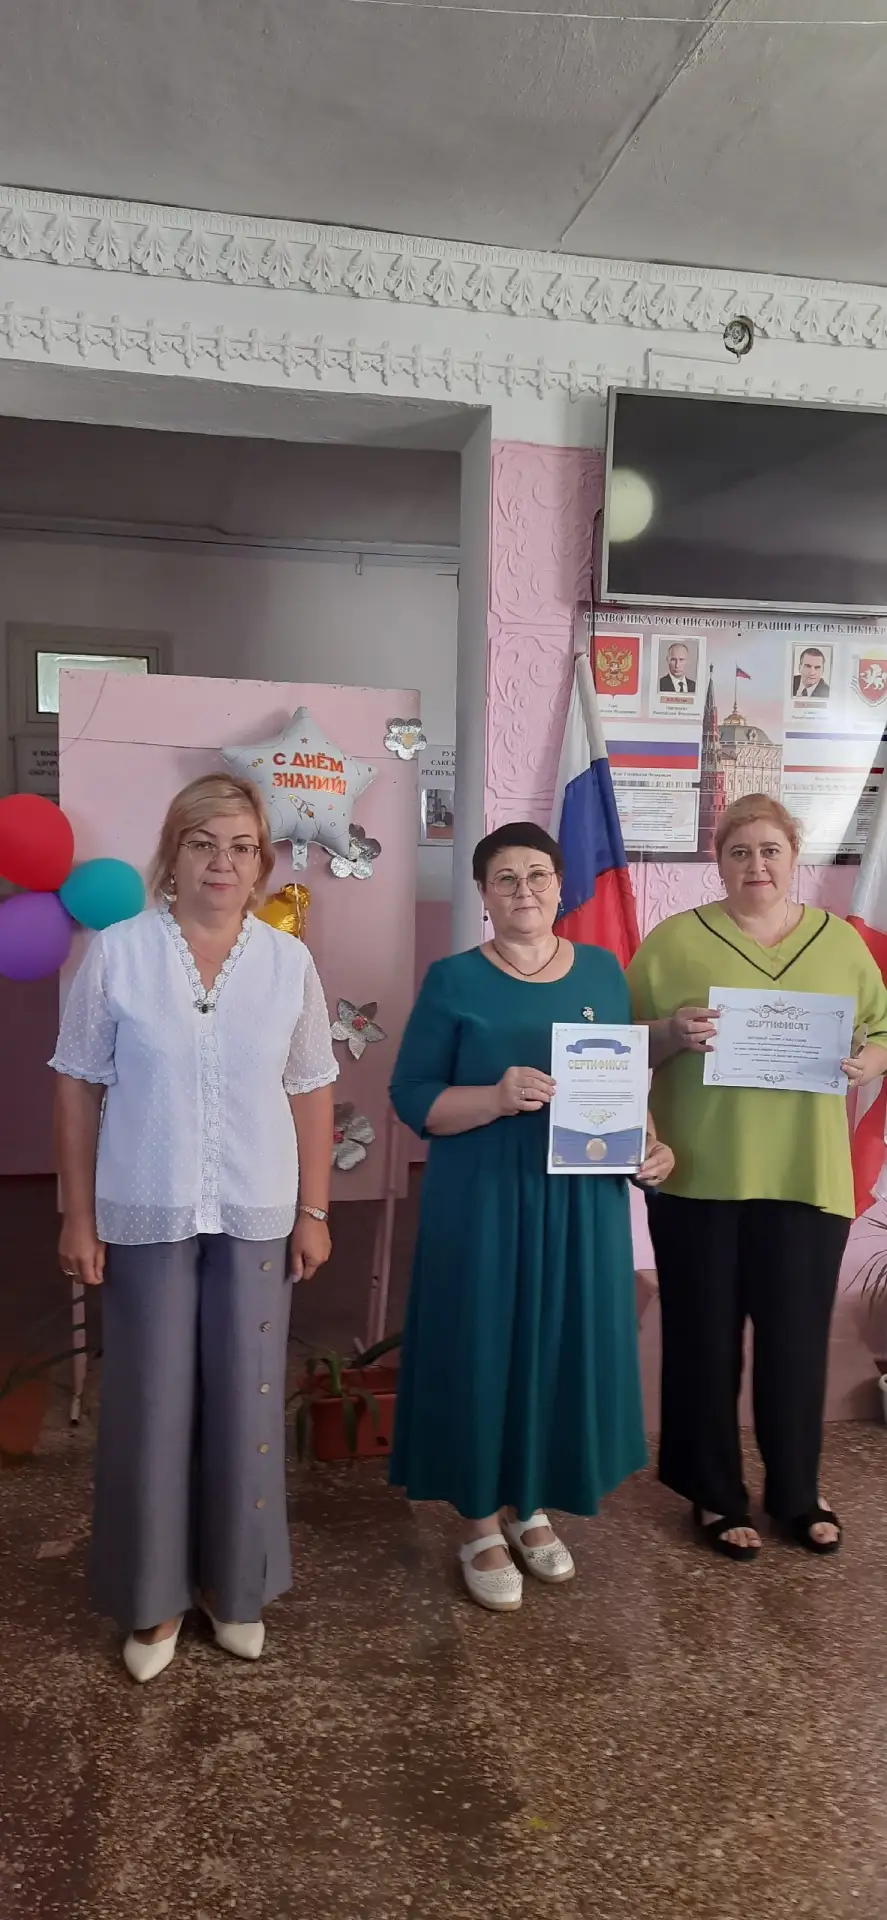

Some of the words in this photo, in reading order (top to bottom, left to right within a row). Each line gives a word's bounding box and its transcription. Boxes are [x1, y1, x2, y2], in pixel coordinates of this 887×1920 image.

[655, 616, 727, 628] РОССИЙСКОЙ
[729, 620, 791, 631] ФЕДЕРАЦИИ
[793, 622, 801, 632] И
[804, 623, 871, 634] РЕСПУБЛИКИ
[273, 753, 286, 766] С
[290, 752, 344, 773] ДНЁМ
[272, 772, 347, 795] ЗНАНИЙ!
[746, 1020, 810, 1031] СЕРТИФИКАТ
[568, 1059, 629, 1070] СЕРТИФИКАТ
